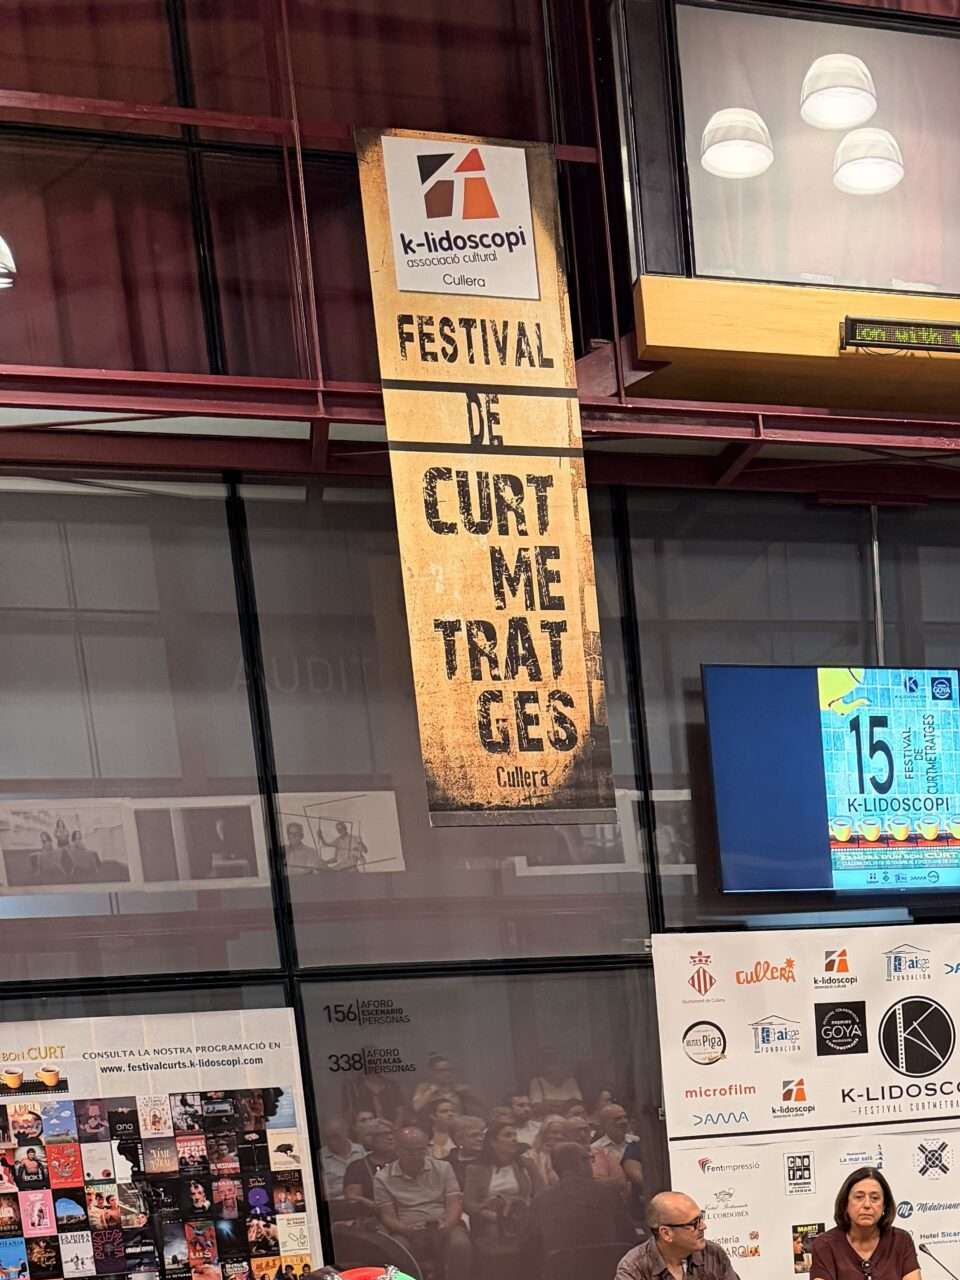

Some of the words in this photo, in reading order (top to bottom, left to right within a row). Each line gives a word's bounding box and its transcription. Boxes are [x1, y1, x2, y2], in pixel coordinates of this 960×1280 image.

[400, 225, 527, 256] k-lidoscopi
[406, 252, 460, 268] associació
[463, 250, 498, 265] cultural
[442, 273, 486, 288] Cullera
[397, 314, 554, 369] FESTIVAL
[466, 391, 503, 447] DE
[423, 466, 553, 537] CURT
[489, 545, 566, 611] ME
[433, 616, 568, 682] TRAT
[477, 689, 579, 754] GES
[850, 714, 894, 795] 15
[902, 727, 914, 780] FESTIVAL
[913, 748, 923, 762] DE
[922, 714, 939, 795] CURTMETRATGES
[496, 766, 549, 789] Cullera
[848, 797, 950, 812] K-LIDOSCOPI
[813, 976, 858, 986] k-lidoscopi
[323, 1004, 357, 1023] 156
[821, 1025, 863, 1039] GOYA
[27, 1045, 66, 1060] CURT
[82, 1050, 135, 1060] CONSULTA
[138, 1049, 151, 1057] LA
[153, 1047, 193, 1056] NOSTRA
[195, 1041, 265, 1054] PROGRAMACIÓ
[269, 1042, 281, 1050] EN
[328, 1053, 363, 1072] 338
[685, 1084, 756, 1099] microfilm
[772, 1105, 815, 1116] k-lidoscopi
[706, 1161, 760, 1173] Fentimpressió
[920, 1232, 940, 1240] Hotel
